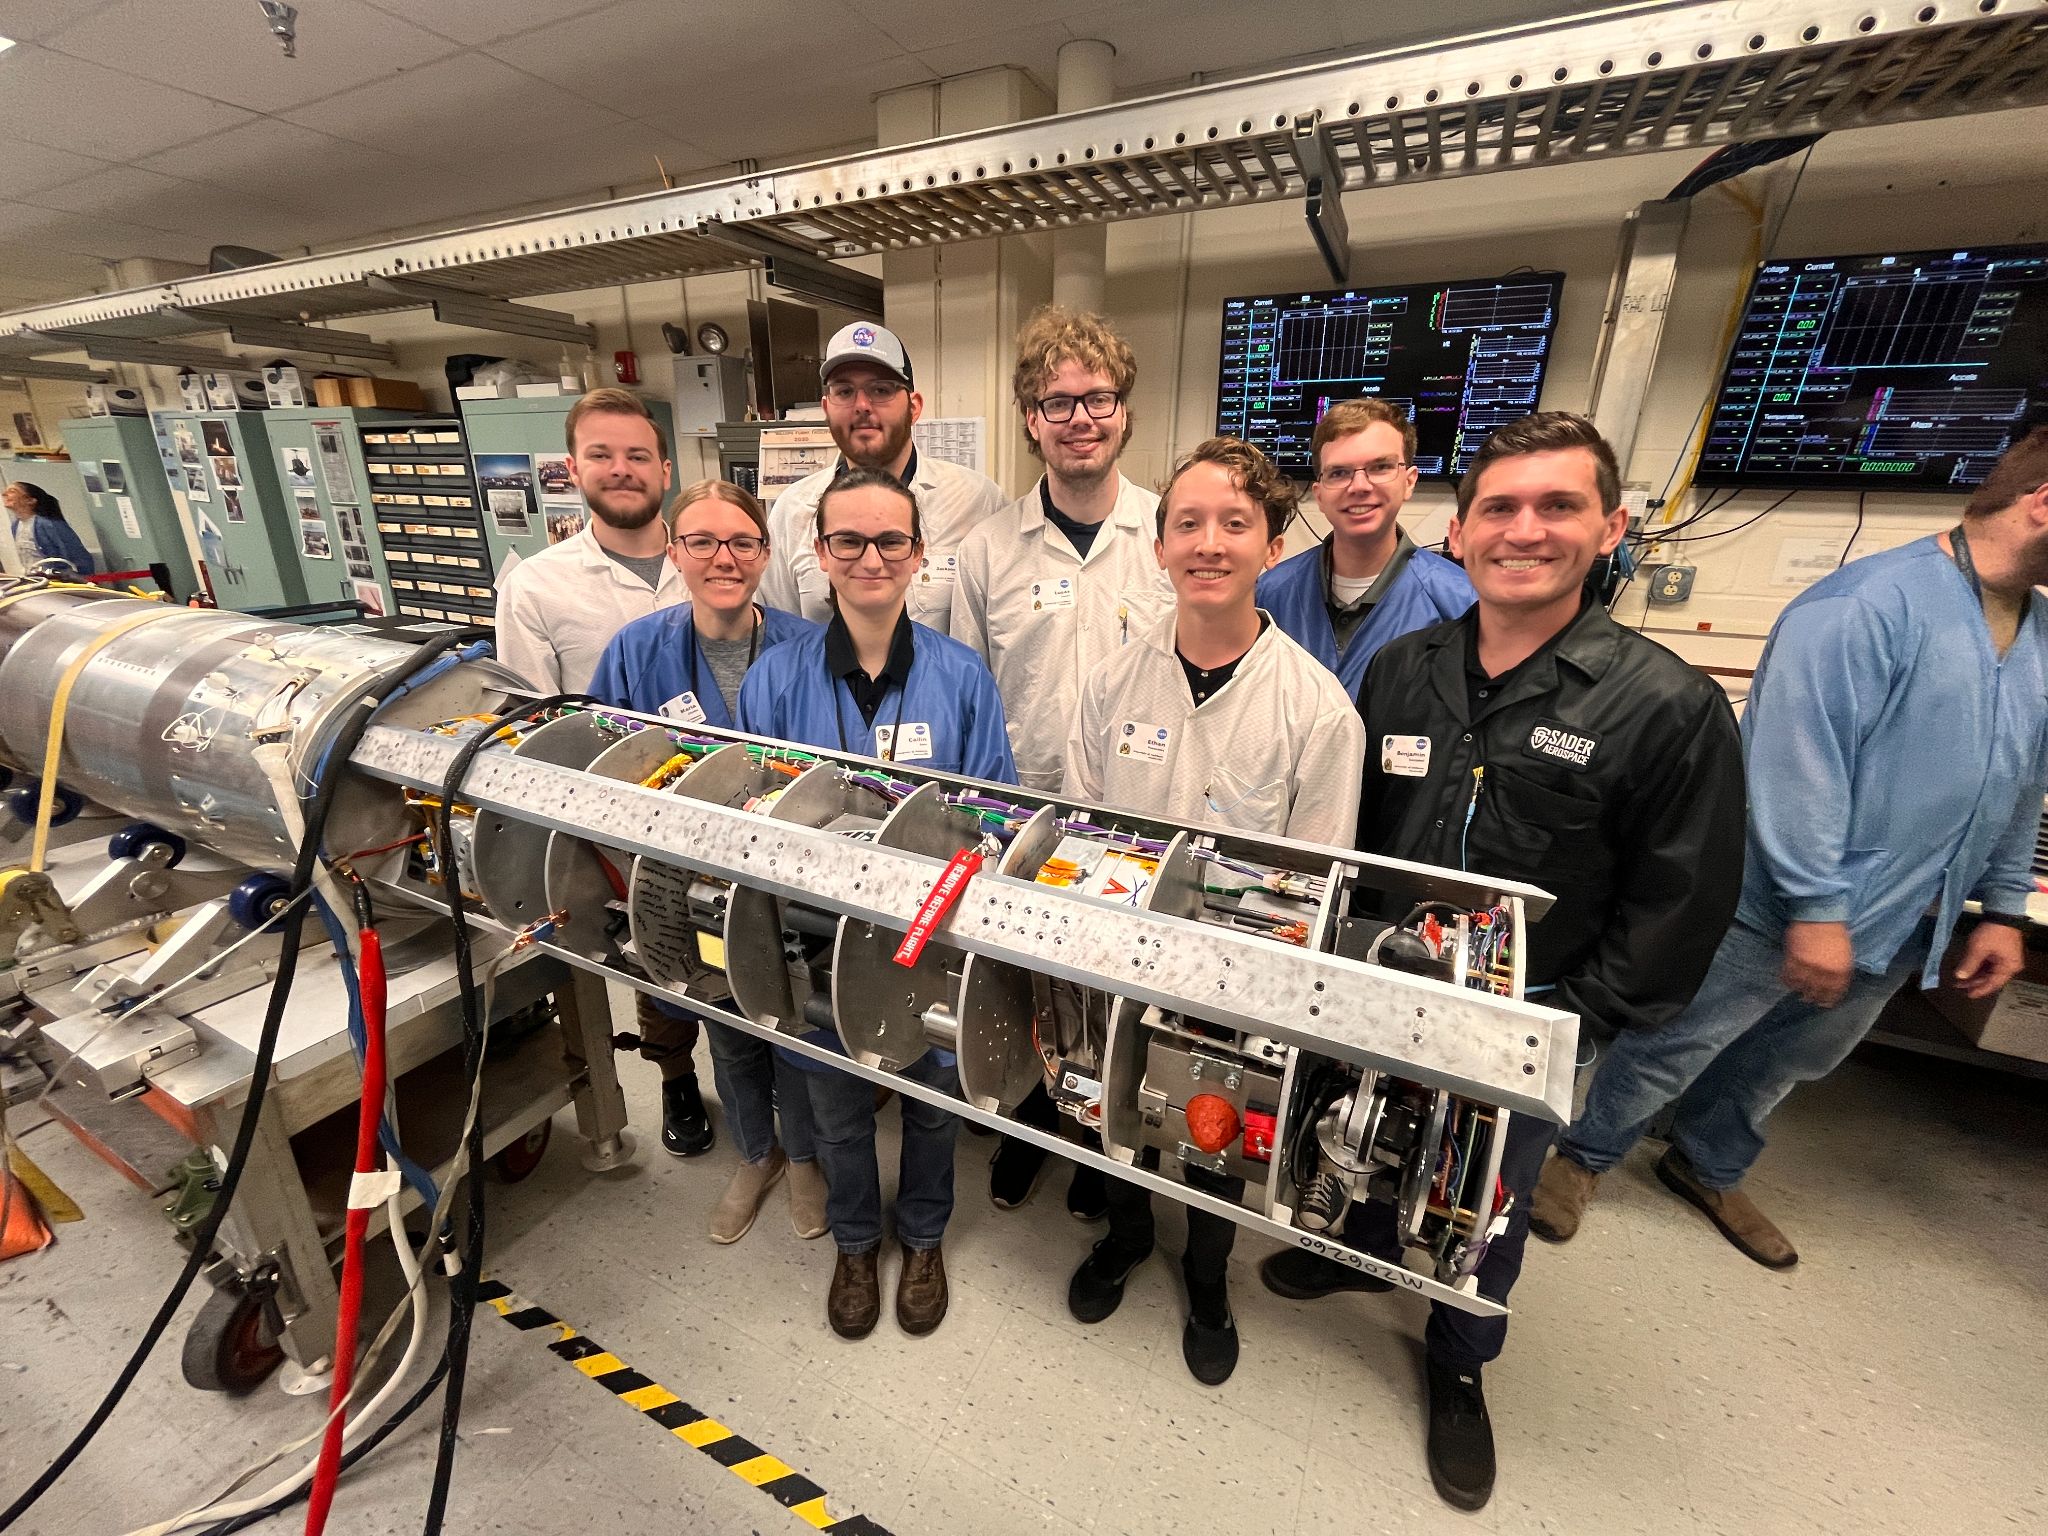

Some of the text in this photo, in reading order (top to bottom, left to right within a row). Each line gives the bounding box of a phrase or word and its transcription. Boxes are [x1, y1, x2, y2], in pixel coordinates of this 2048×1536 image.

[1804, 262, 1835, 271] Current
[1764, 413, 1805, 421] Temperature
[1147, 739, 1166, 747] Ethan
[1547, 729, 1596, 757] SADER
[1542, 743, 1590, 766] AEROSPACE
[901, 862, 968, 959] REMOVE BEFORE FLIGHT
